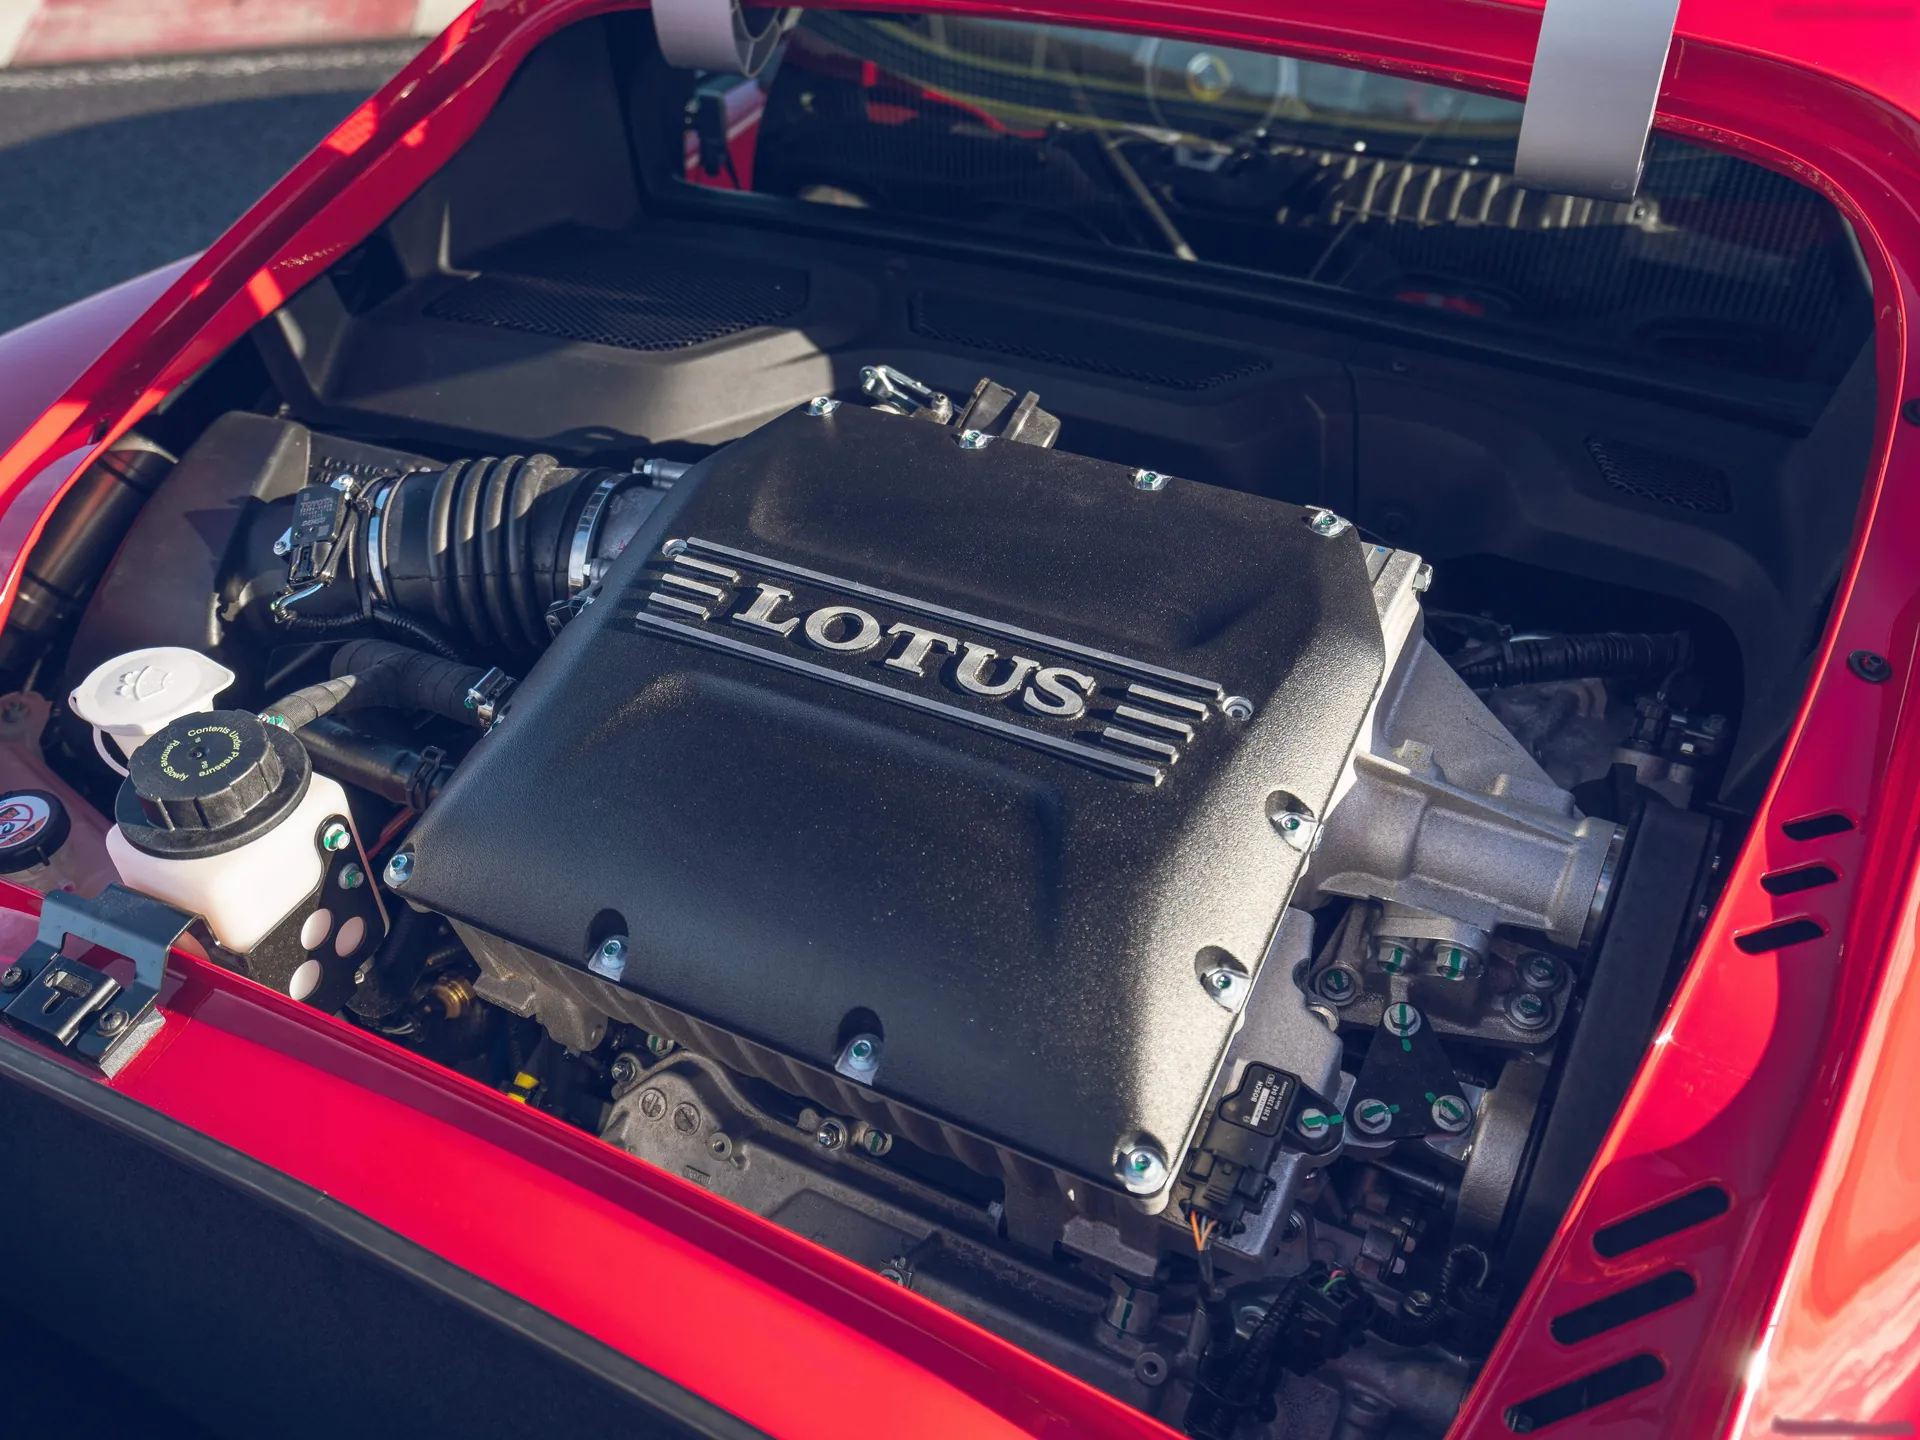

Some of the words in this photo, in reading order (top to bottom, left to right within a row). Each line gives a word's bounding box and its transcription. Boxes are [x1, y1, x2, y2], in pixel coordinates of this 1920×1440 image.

[732, 582, 1097, 720] LOTUS
[187, 725, 231, 737] Contents
[229, 730, 242, 751] Under
[161, 739, 180, 768] Remove
[198, 751, 240, 777] Pressure
[163, 766, 189, 782] Slowly
[1251, 1081, 1263, 1102] BOSCH
